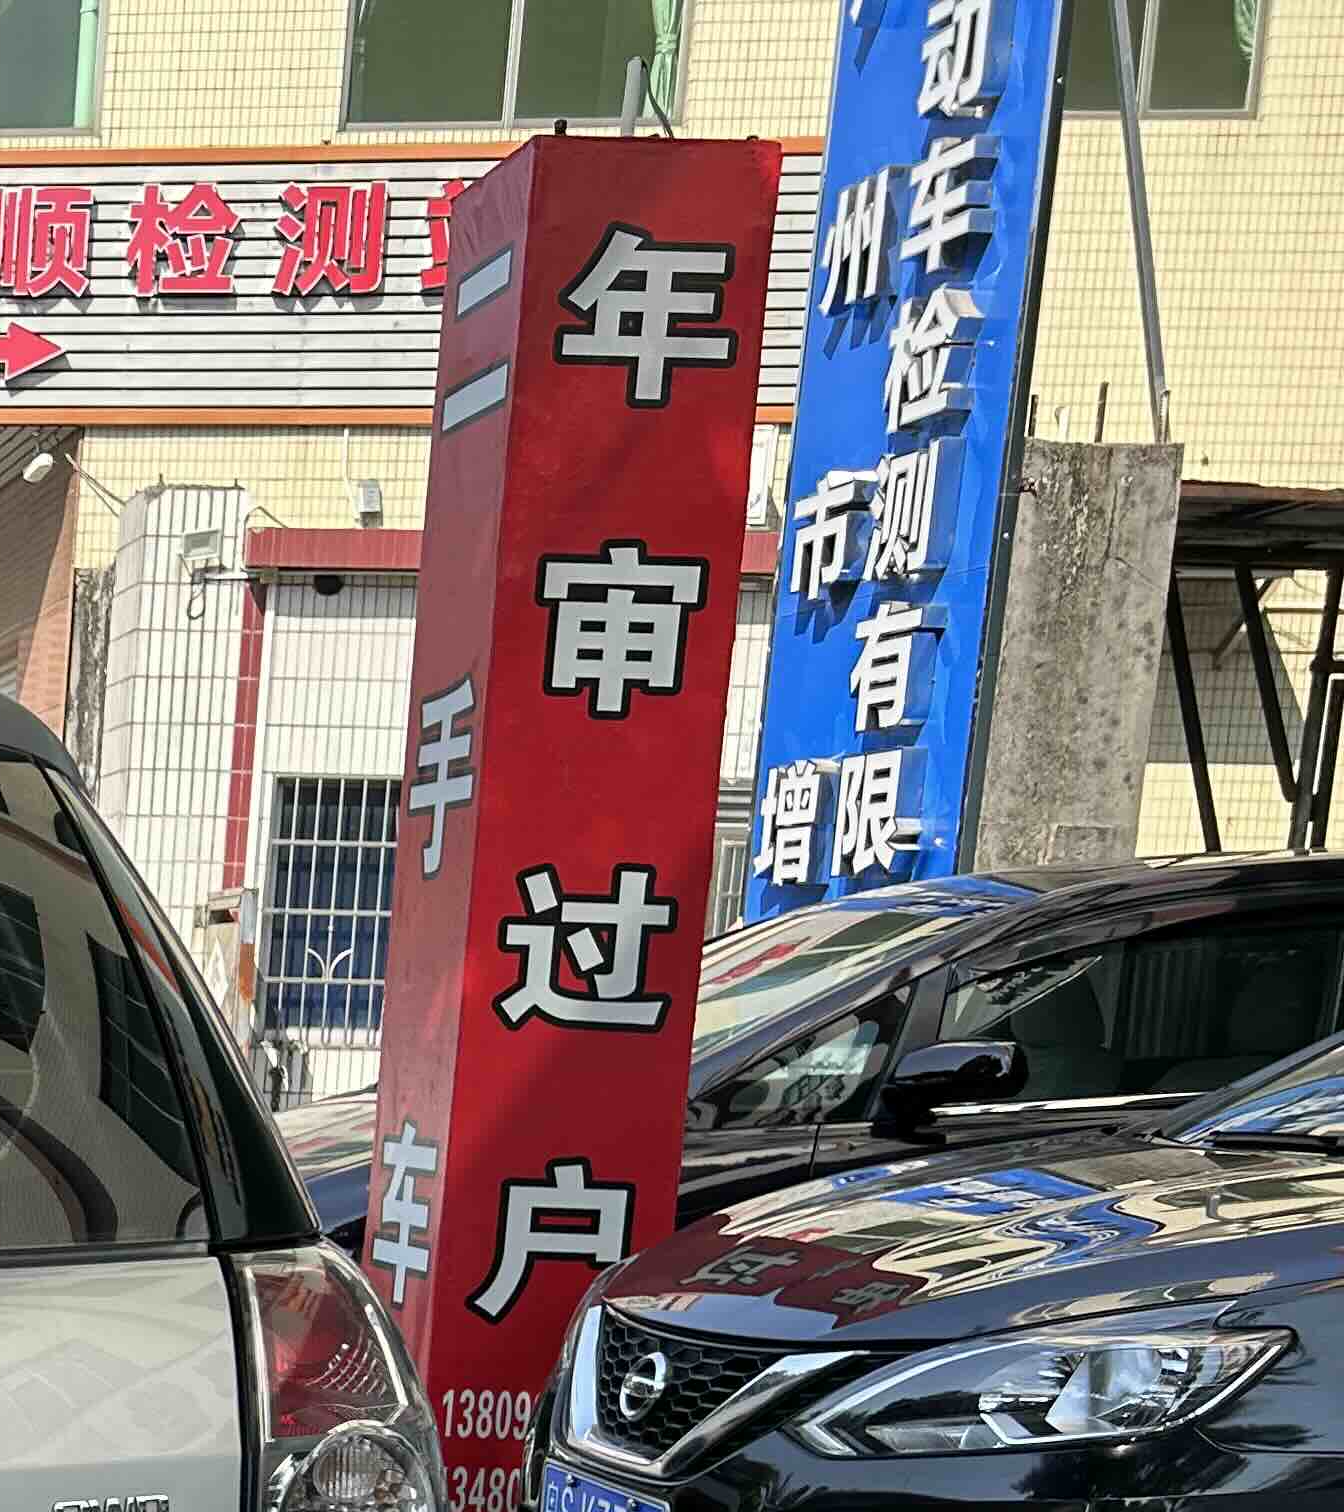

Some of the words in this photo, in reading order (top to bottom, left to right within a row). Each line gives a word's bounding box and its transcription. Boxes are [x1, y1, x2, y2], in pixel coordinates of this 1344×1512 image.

[372, 248, 513, 1305] 二手车
[470, 226, 735, 1319] 年审过户
[753, 0, 890, 888] 州市增
[442, 1389, 542, 1440] 13809
